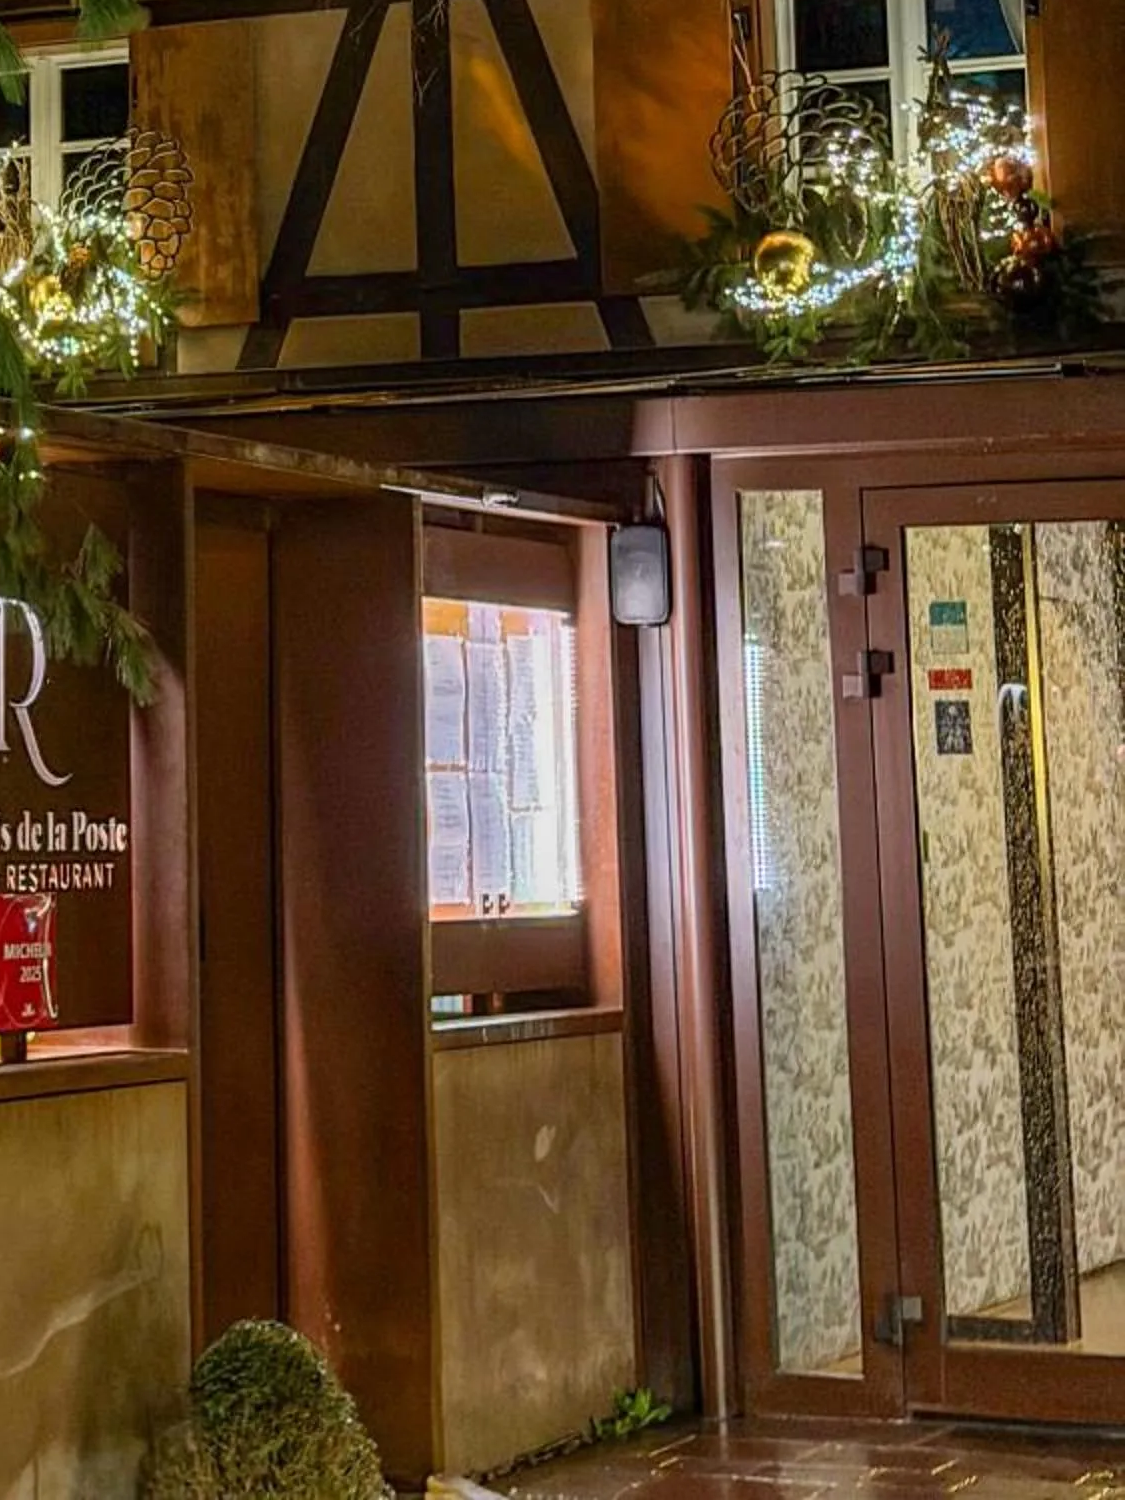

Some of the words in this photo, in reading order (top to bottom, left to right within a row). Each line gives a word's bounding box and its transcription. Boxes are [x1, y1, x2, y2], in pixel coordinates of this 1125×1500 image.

[16, 810, 42, 852] de
[47, 811, 68, 852] la
[72, 811, 128, 852] Poste
[6, 863, 114, 892] RESTAURANT
[4, 942, 52, 960] MICHEL
